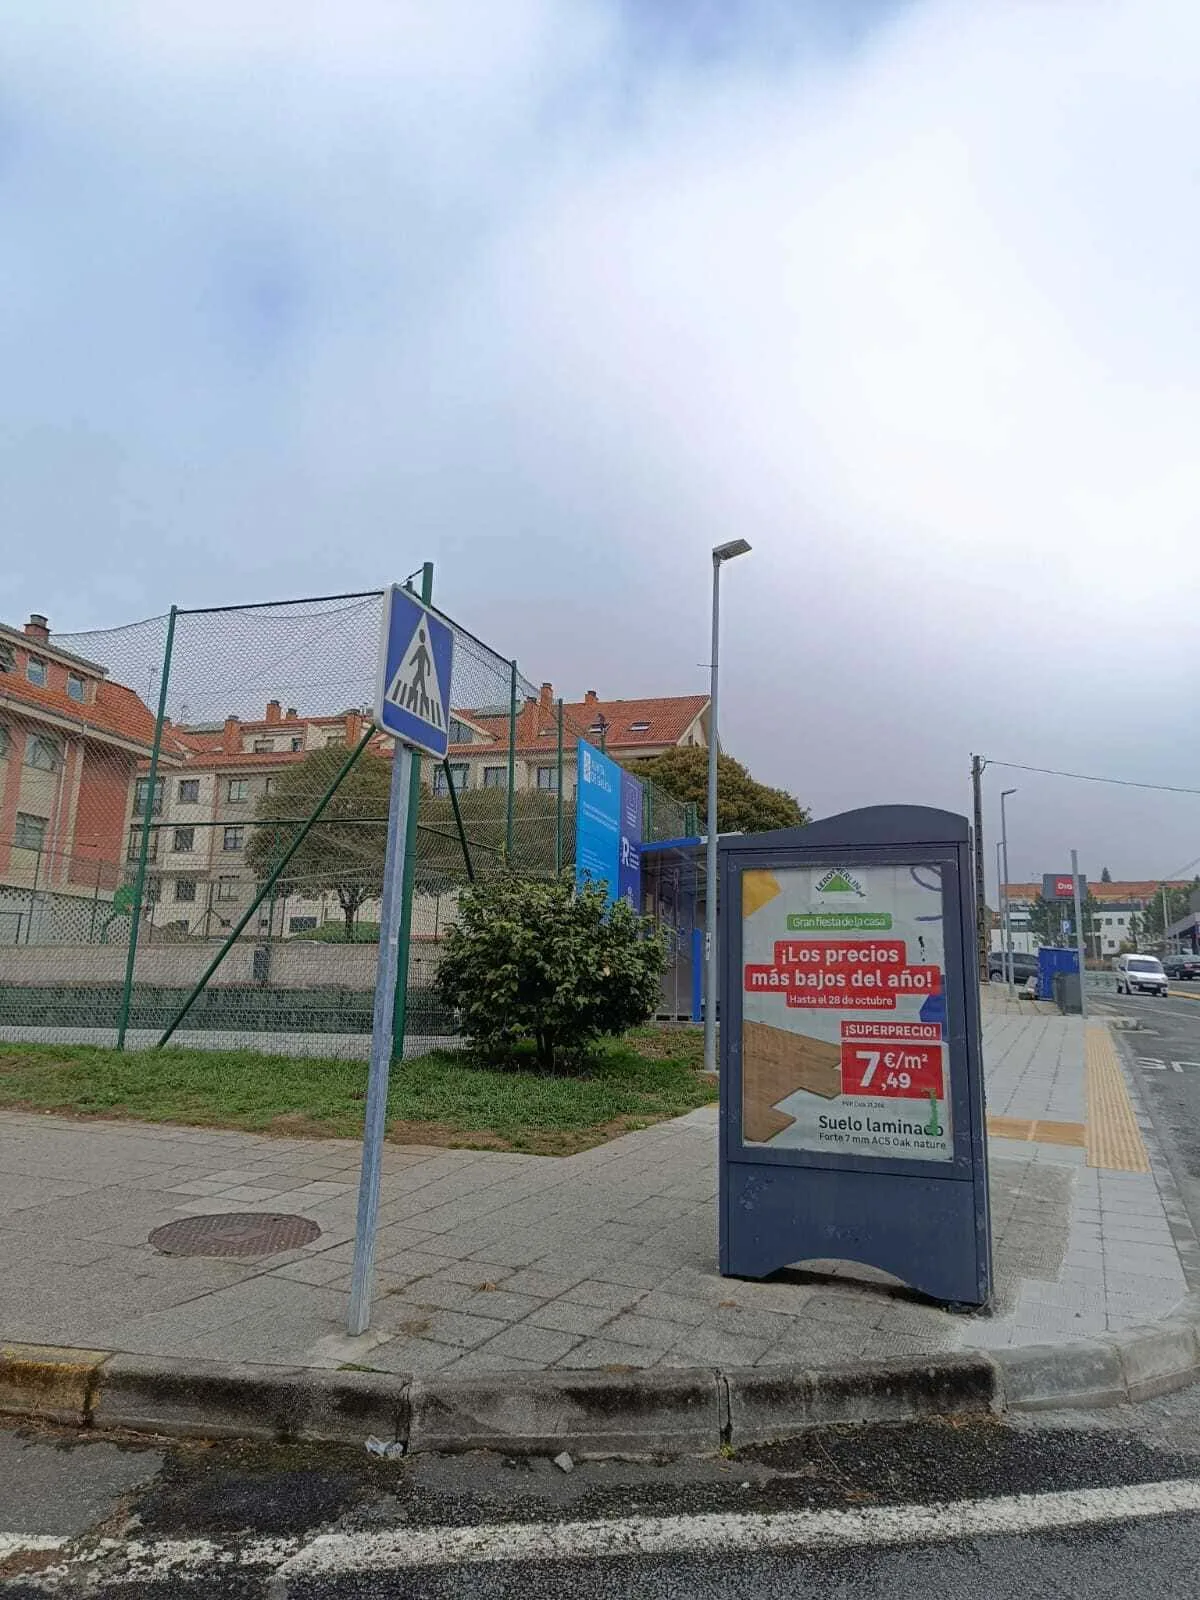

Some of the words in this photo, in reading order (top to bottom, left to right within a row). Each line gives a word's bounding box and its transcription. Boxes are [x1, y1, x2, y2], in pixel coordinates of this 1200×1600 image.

[793, 916, 814, 927] Gran
[816, 916, 840, 927] fiesta
[841, 916, 853, 927] de
[864, 918, 885, 927] casa
[782, 944, 821, 964] ¡Los
[826, 945, 899, 967] precios
[751, 969, 789, 986] más
[795, 969, 846, 990] bajos
[851, 970, 882, 987] del
[888, 971, 932, 988] año!
[789, 995, 817, 1004] Hasta
[818, 995, 827, 1004] el
[829, 996, 840, 1005] 28
[842, 996, 853, 1005] de
[855, 996, 893, 1006] octubre
[845, 1023, 937, 1037] ¡SUPERPRECIO!
[855, 1050, 881, 1087] 7
[818, 1115, 862, 1130] Suelo
[819, 1132, 843, 1142] Forte
[845, 1134, 850, 1142] 7
[852, 1136, 870, 1144] mm
[893, 1138, 911, 1147] Oak
[914, 1140, 947, 1150] nature
